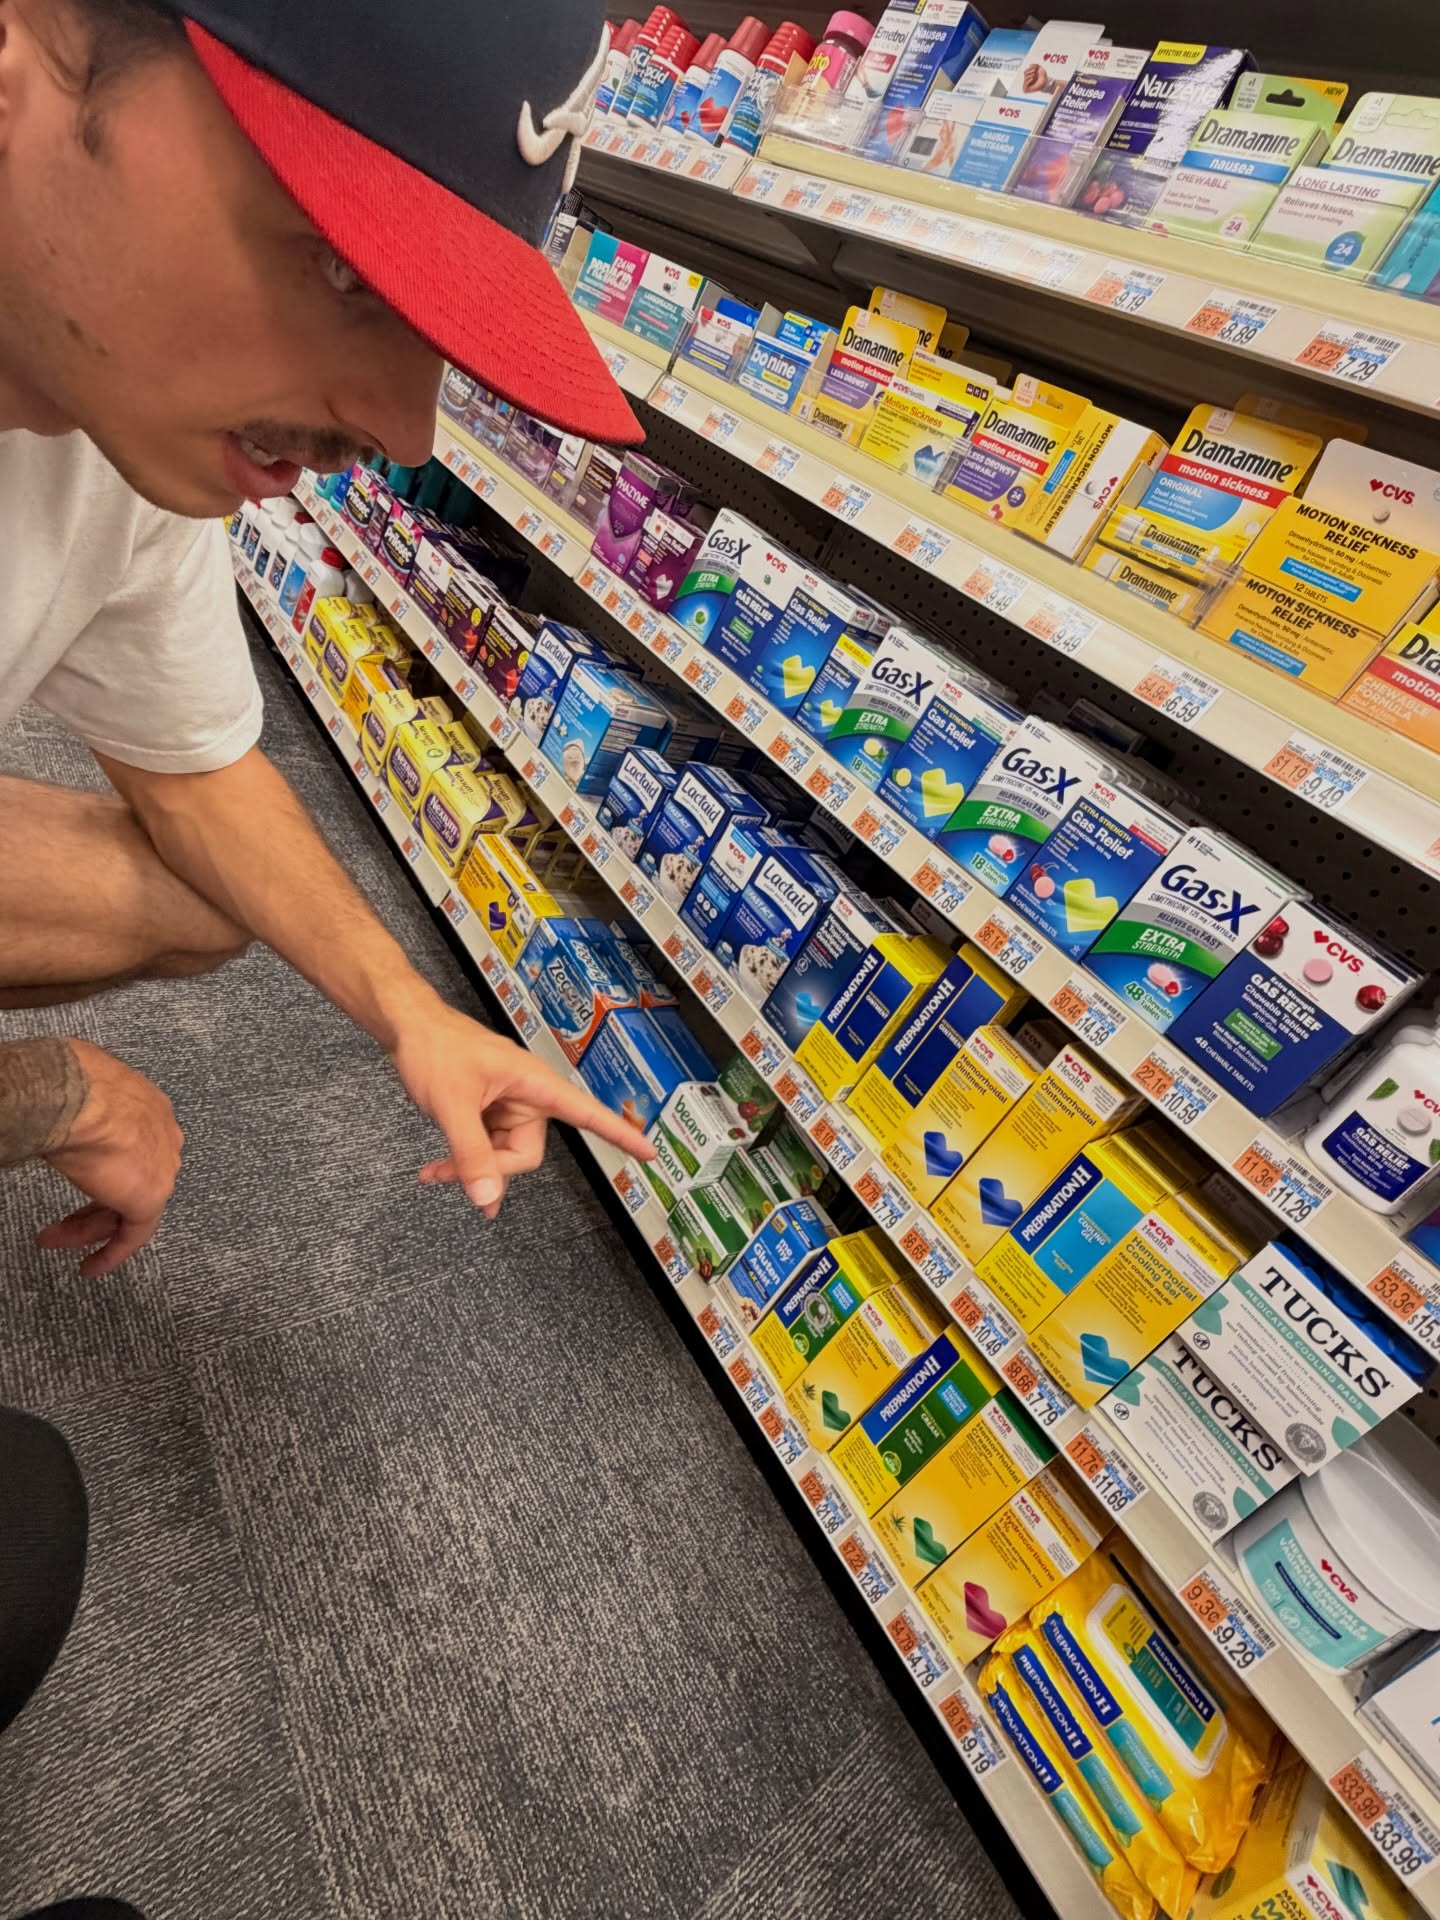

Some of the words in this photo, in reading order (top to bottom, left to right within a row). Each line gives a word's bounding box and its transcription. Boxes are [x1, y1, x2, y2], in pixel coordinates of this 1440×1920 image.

[875, 26, 909, 45] Emetrol
[908, 40, 935, 54] Relief
[915, 27, 948, 43] Nausea
[1048, 53, 1067, 65] CVS
[1083, 58, 1106, 72] Health
[1094, 50, 1110, 61] CVS
[1061, 95, 1092, 110] Relief
[1068, 83, 1106, 100] Nausea
[1324, 86, 1345, 96] NEW
[1004, 108, 1021, 119] CVS
[1198, 119, 1299, 156] Dramamine
[1210, 160, 1254, 175] nausea
[1332, 137, 1440, 176] Dramamine
[1176, 172, 1229, 191] CHEWABLE
[1296, 176, 1328, 190] LONG
[1329, 182, 1381, 198] LASTING
[1226, 221, 1242, 234] 24
[1334, 244, 1352, 255] 24
[843, 327, 904, 367] Dramamine
[1218, 322, 1258, 345] $8.89
[830, 368, 844, 378] LESS
[843, 372, 868, 389] DROWSY
[841, 357, 864, 372] motion
[864, 366, 892, 384] sickness
[1334, 354, 1380, 383] $7.29
[813, 408, 847, 432] Dramamine
[885, 396, 908, 412] Motion
[910, 407, 942, 428] Sickness
[984, 411, 1057, 455] Dramamine
[1090, 424, 1113, 461] MOTION
[964, 459, 997, 479] CHEWABLE
[980, 437, 1006, 459] motion
[1007, 449, 1038, 471] sickness
[1181, 429, 1295, 484] Dramamine
[616, 475, 649, 508] PHAZYME
[1066, 462, 1091, 505] SICKNESS
[1159, 476, 1203, 499] ORIGINAL
[1177, 462, 1219, 485] motion
[1221, 473, 1273, 501] sickness
[1044, 505, 1064, 534] RELIEF
[1296, 503, 1351, 536] MOTION
[1352, 525, 1419, 561] SICKNESS
[707, 528, 752, 566] Gas-X
[1324, 529, 1370, 556] RELIEF
[771, 557, 788, 574] CVS
[1119, 564, 1178, 605] Dramamine
[1293, 582, 1305, 593] 12
[1304, 586, 1329, 604] TABLETS
[789, 597, 809, 616] Gas
[804, 610, 832, 634] Relief
[1245, 579, 1295, 607] MOTION
[1294, 600, 1360, 639] SICKNESS
[1271, 606, 1315, 631] RELIEF
[540, 633, 568, 667] Lactaid
[871, 657, 934, 706] Gas-X
[858, 712, 888, 726] EXTRA
[1025, 719, 1035, 731] #1
[1162, 694, 1200, 723] $6.59
[927, 709, 946, 729] Gas
[945, 723, 976, 751] Relief
[624, 758, 658, 801] Lactaid
[852, 757, 861, 770] 18
[1001, 747, 1082, 804] Gas-X
[1271, 756, 1308, 782] $1.19
[681, 778, 720, 823] Lactaid
[1100, 787, 1117, 802] CVS
[1301, 776, 1345, 808] $9.49
[430, 793, 459, 835] Nexium
[665, 804, 679, 820] FAST
[676, 815, 690, 830] ACT
[976, 816, 1017, 830] STRENGTH
[983, 805, 1022, 824] EXTRA
[1079, 802, 1099, 820] EXTRA
[1098, 816, 1132, 842] STRENGTH
[1071, 810, 1097, 834] Gas
[1095, 829, 1134, 861] Relief
[1187, 834, 1201, 850] #1
[732, 848, 747, 864] CVS
[970, 854, 986, 870] 18
[763, 862, 815, 917] Lactaid
[1160, 864, 1262, 936] Gas-X
[1148, 893, 1190, 915] SIMETHICONE
[1188, 908, 1199, 918] 125
[1198, 915, 1208, 926] mg
[1210, 922, 1238, 943] ANTIGAS
[1132, 939, 1181, 959] STRENGTH
[1138, 929, 1187, 953] EXTRA
[1325, 941, 1366, 973] CVS
[826, 967, 868, 1025] PREPARATION
[1124, 981, 1145, 1001] 48
[1250, 973, 1280, 1002] GAS
[1272, 992, 1324, 1033] RELIEF
[894, 991, 943, 1055] PREPARATION
[1076, 1017, 1110, 1047] $14.59
[979, 1042, 995, 1060] CVS
[955, 1060, 987, 1096] Ointment
[959, 1053, 1008, 1105] Hemorrhoidal
[1040, 1083, 1076, 1119] Ointment
[1045, 1074, 1097, 1127] Hemorrhoidal
[674, 1094, 708, 1148] beano
[653, 1130, 685, 1183] beano
[872, 1201, 898, 1229] $7.79
[1021, 1183, 1077, 1242] PREPARATION
[1266, 1186, 1313, 1223] $11.29
[753, 1242, 780, 1286] Gluten
[919, 1258, 948, 1289] $13.29
[1126, 1244, 1161, 1281] Cooling
[1162, 1280, 1181, 1299] Gel
[1132, 1236, 1198, 1302] Hemorrhoidal
[782, 1271, 825, 1317] PREPARATION
[868, 1311, 883, 1327] CVS
[1259, 1266, 1391, 1398] TUCKS
[854, 1316, 893, 1368] Hemorrhoidal
[973, 1326, 1002, 1357] $10.49
[1245, 1289, 1294, 1340] MEDICATED
[1294, 1340, 1336, 1383] COOLING
[1337, 1383, 1364, 1412] PADS
[1007, 1359, 1031, 1391] $8.66
[879, 1368, 931, 1423] PREPARATION
[1025, 1392, 1058, 1427] $7.79
[1172, 1346, 1283, 1472] TUCKS
[996, 1414, 1012, 1434] CVS
[775, 1436, 797, 1465] $7.79
[970, 1427, 995, 1458] Cream
[975, 1421, 1021, 1484] Hemorrhoidal
[1091, 1473, 1128, 1512] $11.69
[1026, 1504, 1040, 1524] CVS
[1003, 1511, 1055, 1582] Hydrocortisone
[856, 1571, 883, 1604] $12.99
[1049, 1617, 1101, 1698] PREPARATION
[1212, 1625, 1255, 1669] $9.29
[907, 1654, 936, 1688] $4.79
[1151, 1639, 1199, 1703] PREPARATION
[1018, 1653, 1072, 1734] PREPARATION
[993, 1692, 1044, 1776] PREPARATION
[960, 1735, 990, 1775] $9.19
[1338, 1772, 1380, 1822] $33.99
[1370, 1821, 1423, 1877] $33.99
